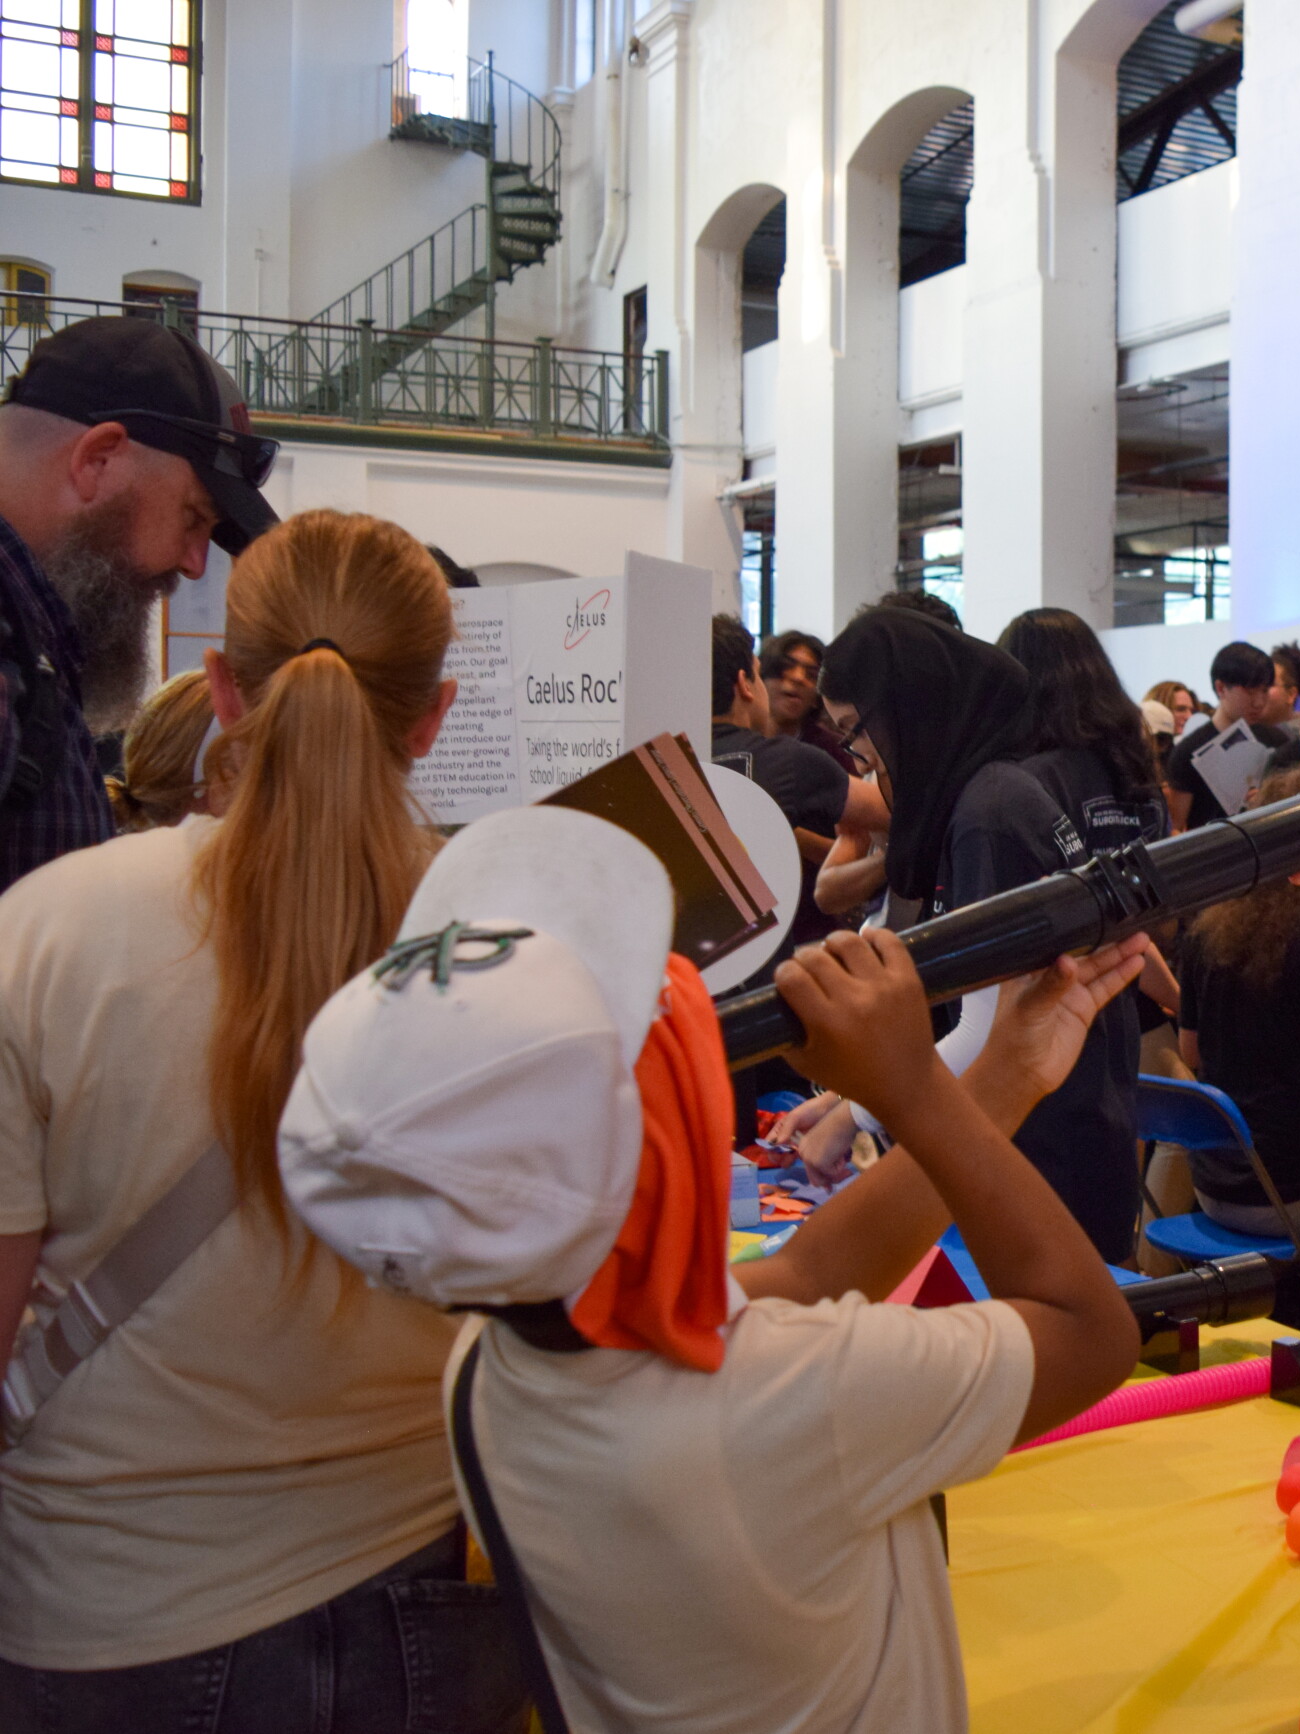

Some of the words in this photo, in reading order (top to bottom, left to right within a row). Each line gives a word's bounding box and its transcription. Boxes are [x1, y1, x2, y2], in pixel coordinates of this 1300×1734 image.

[493, 631, 502, 640] of
[461, 645, 485, 654] from
[486, 644, 501, 653] the
[470, 658, 486, 667] Our
[488, 656, 508, 668] goal
[478, 669, 496, 679] and
[459, 683, 481, 695] high
[526, 672, 576, 704] Caelus
[451, 709, 461, 719] to
[462, 708, 478, 718] the
[479, 708, 503, 720] edge
[503, 707, 513, 716] of
[446, 722, 484, 733] creating
[450, 733, 494, 744] introduce
[435, 747, 449, 757] the
[452, 746, 510, 759] ever-growing
[526, 737, 552, 762] Taking
[552, 737, 569, 757] the
[571, 737, 613, 758] world's
[427, 758, 465, 773] industry
[467, 759, 484, 768] and
[486, 759, 502, 768] the
[421, 775, 431, 784] of
[432, 773, 457, 784] STEM
[459, 772, 504, 782] education
[506, 771, 516, 780] in
[530, 765, 555, 785] school
[447, 784, 508, 797] technological
[430, 799, 457, 809] world.
